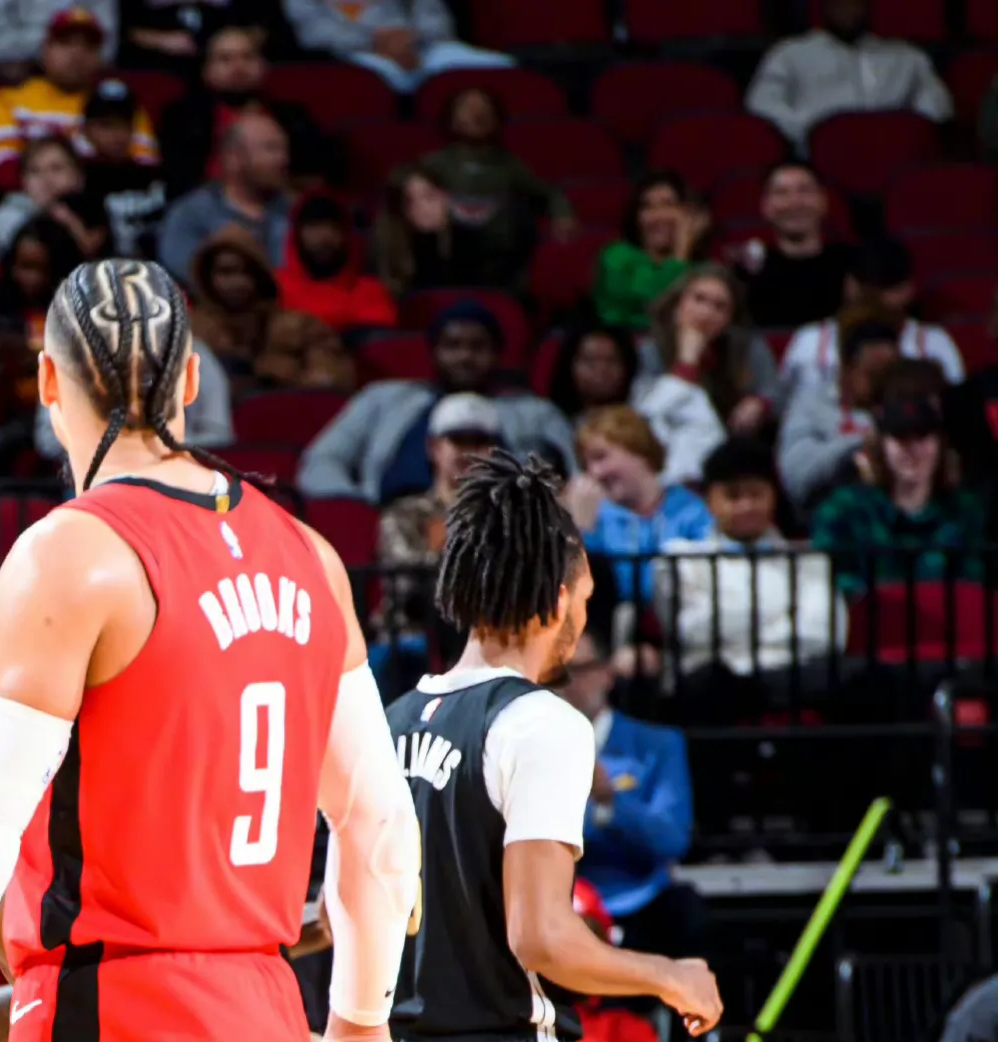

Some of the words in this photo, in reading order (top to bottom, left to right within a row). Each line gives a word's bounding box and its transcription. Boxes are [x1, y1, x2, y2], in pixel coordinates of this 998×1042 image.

[198, 572, 311, 651] BROOKS
[229, 681, 286, 867] 9
[396, 731, 462, 791] LIAMS
